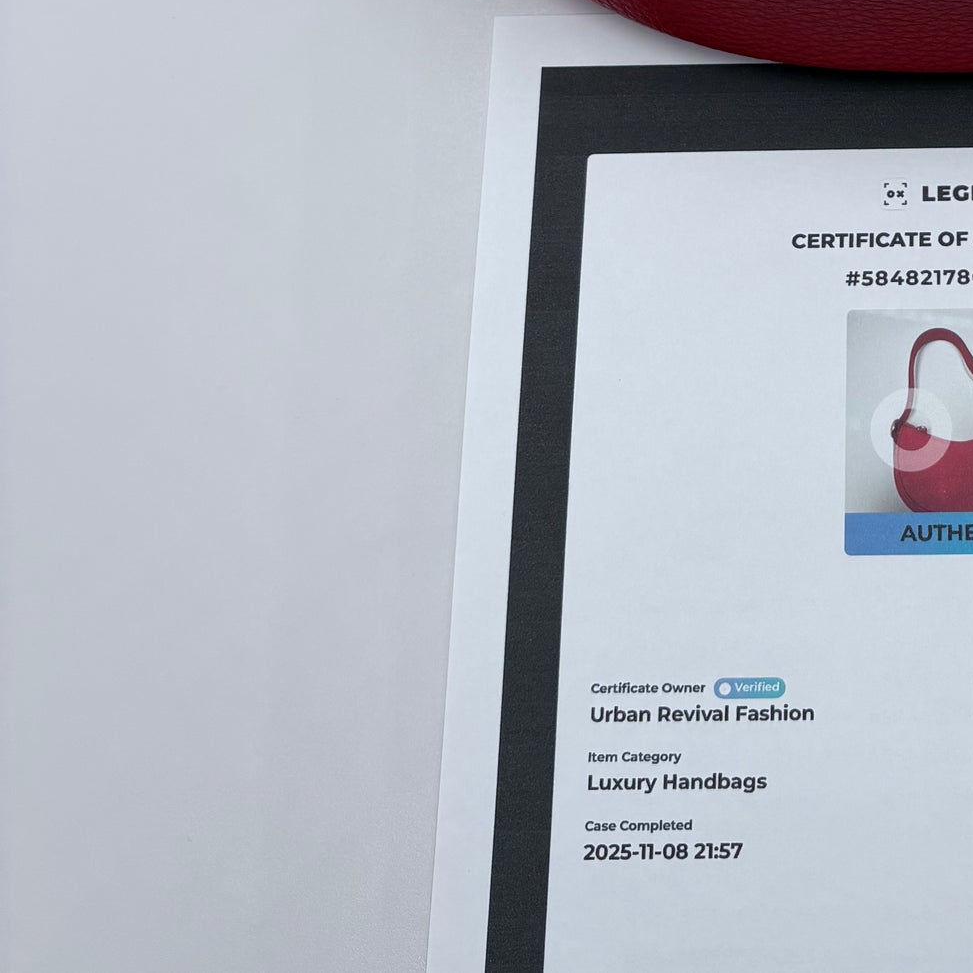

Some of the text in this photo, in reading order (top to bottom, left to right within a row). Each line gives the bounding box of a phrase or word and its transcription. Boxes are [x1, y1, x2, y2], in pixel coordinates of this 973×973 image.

[791, 231, 932, 250] CERTIFICATE
[937, 230, 969, 247] OF
[590, 681, 780, 694] Certificate Owner Verified
[590, 703, 815, 723] Urban Revival Fashion
[587, 751, 682, 765] Item Category
[587, 772, 768, 795] Luxury Handbags
[584, 818, 693, 834] Case Completed
[583, 842, 744, 861] 2025-11-08 21:57
